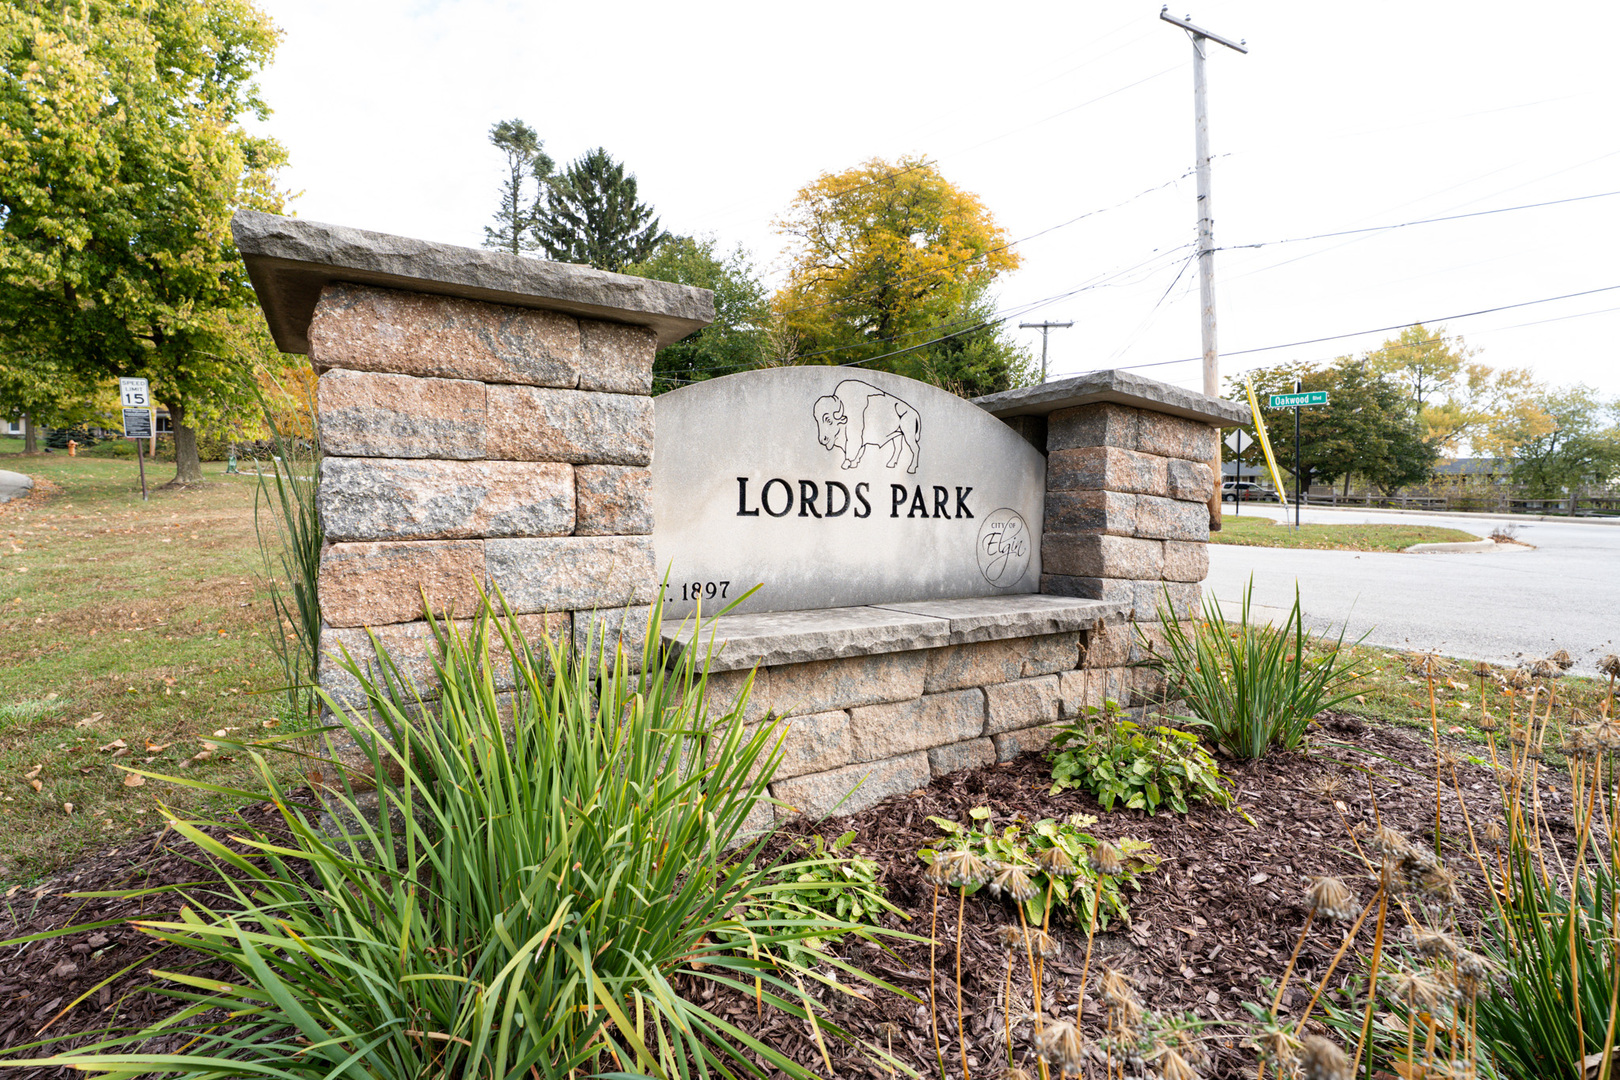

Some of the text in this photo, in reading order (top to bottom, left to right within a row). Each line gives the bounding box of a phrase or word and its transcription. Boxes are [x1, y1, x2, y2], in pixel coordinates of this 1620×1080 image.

[126, 394, 144, 404] 15
[1276, 395, 1308, 405] Oakwood
[737, 477, 975, 520] LORDS PARK
[982, 516, 1027, 581] Elgin
[682, 581, 730, 600] 1897
